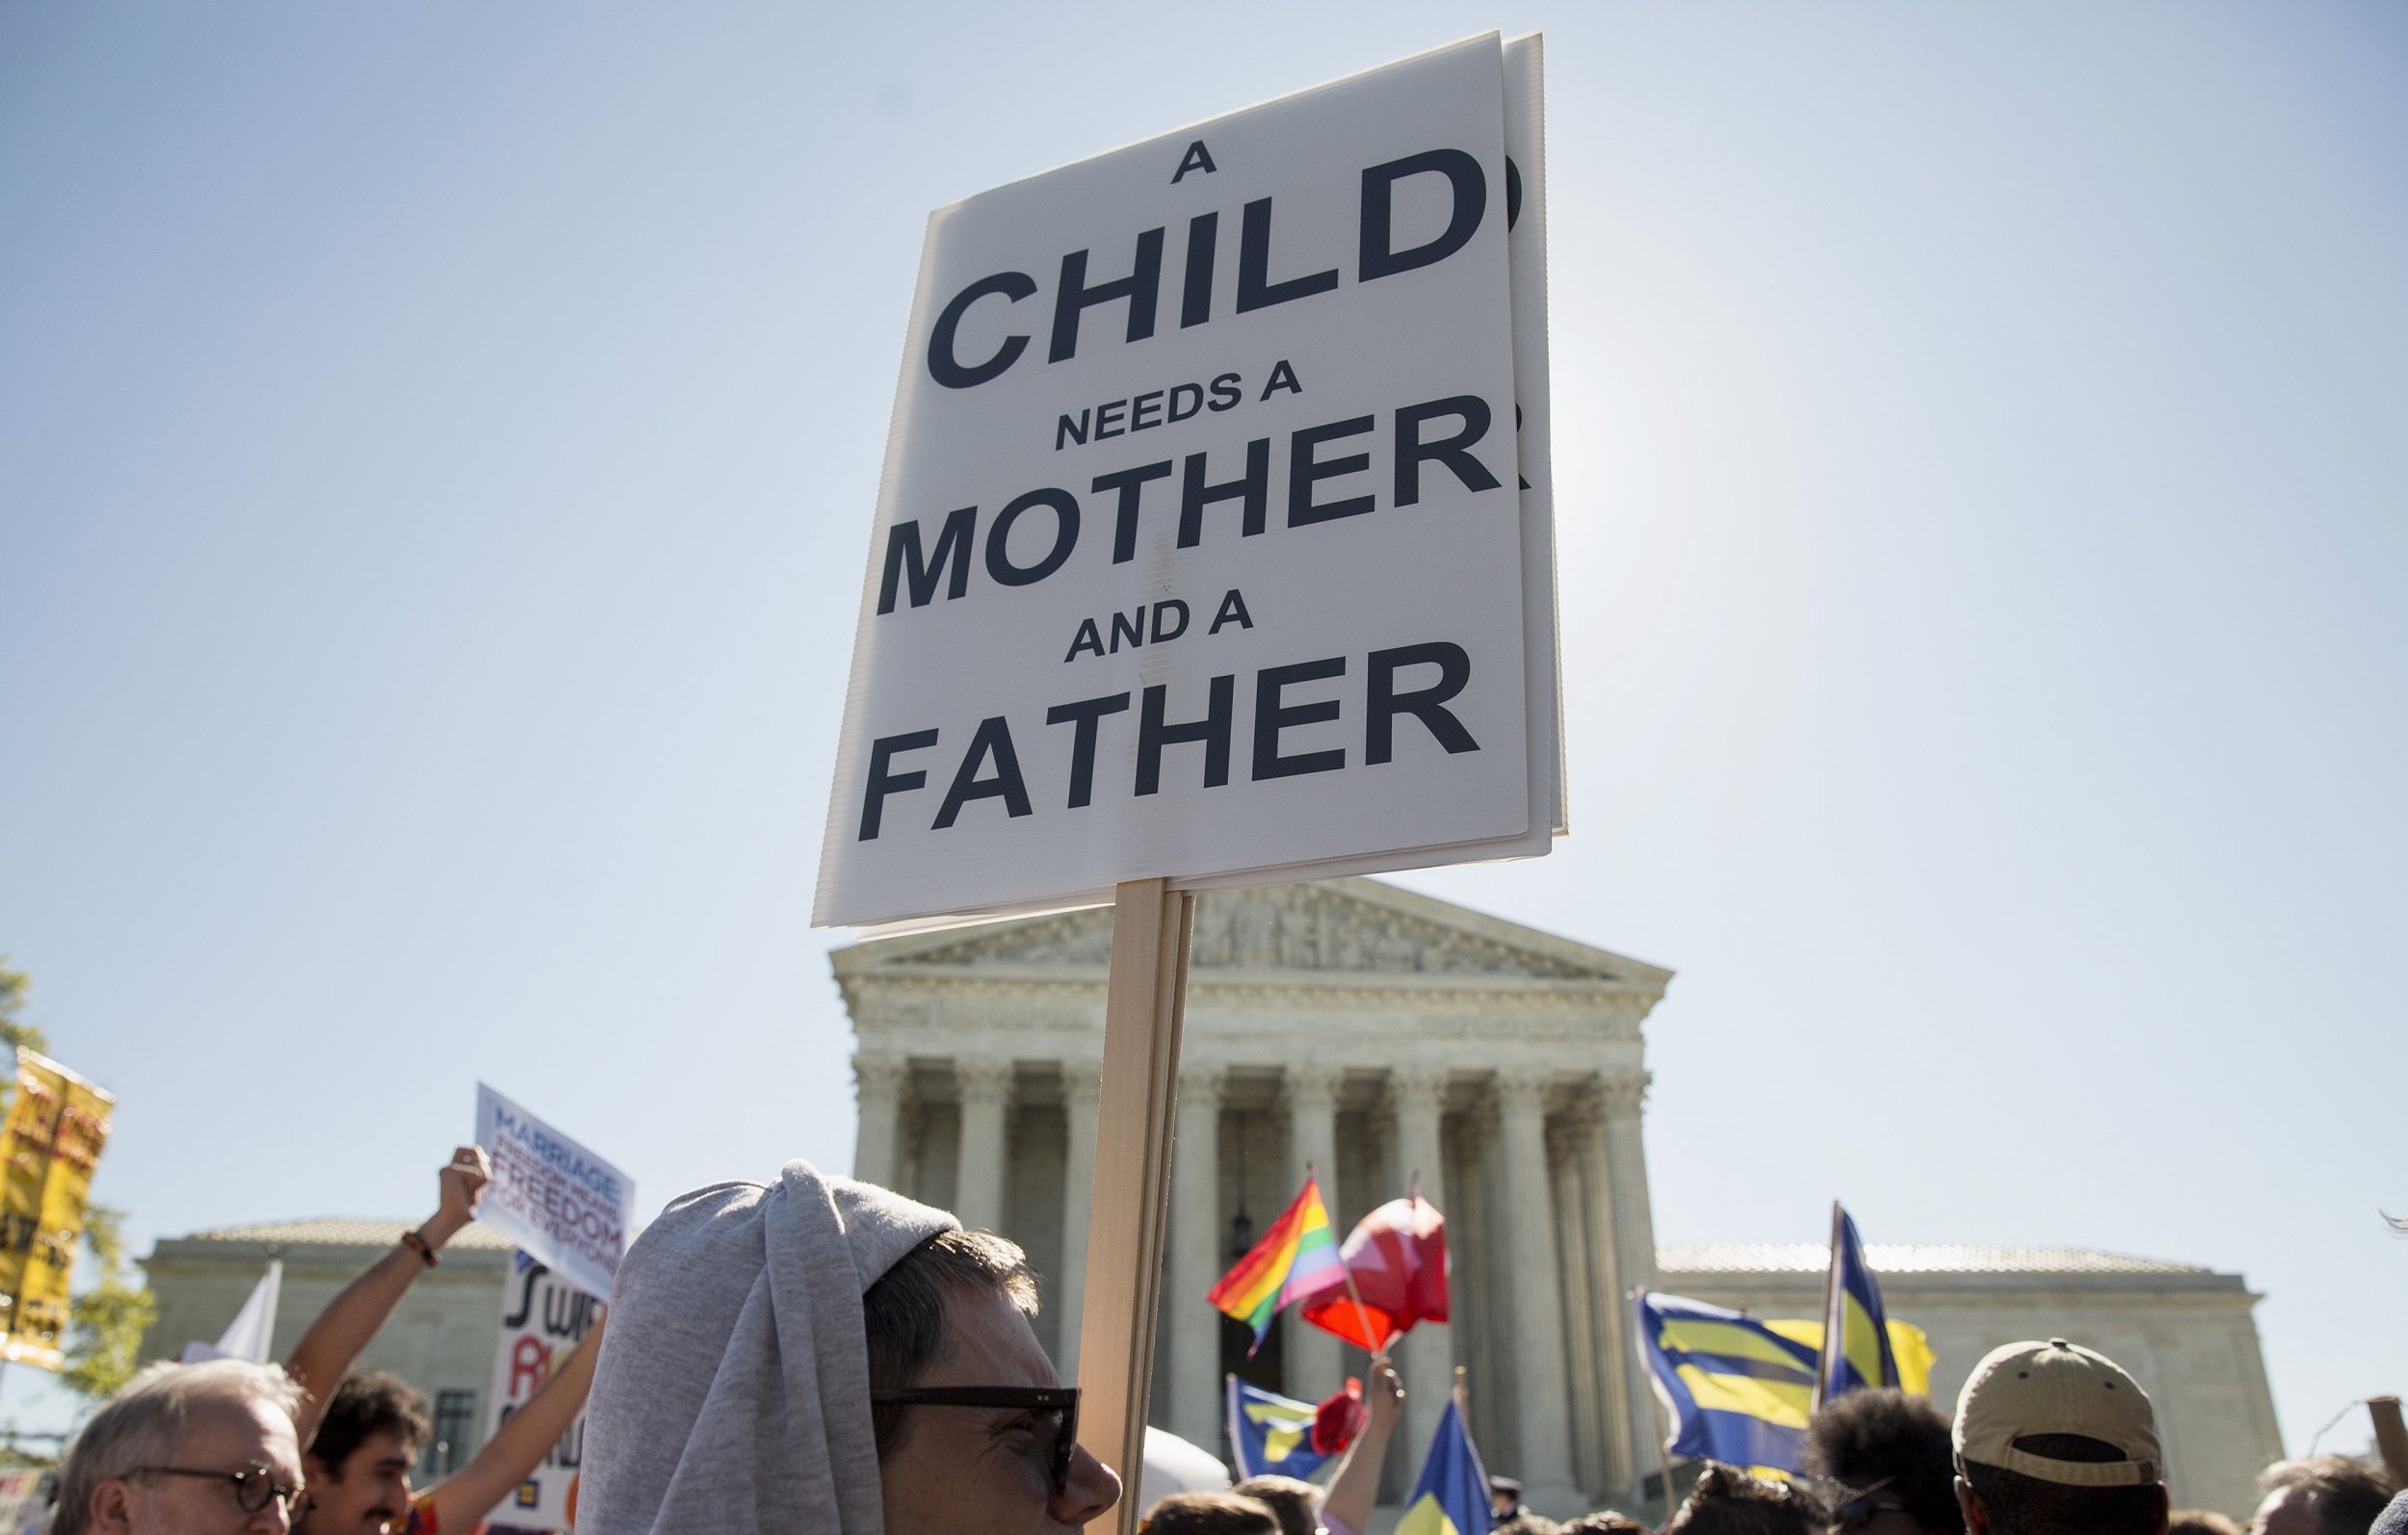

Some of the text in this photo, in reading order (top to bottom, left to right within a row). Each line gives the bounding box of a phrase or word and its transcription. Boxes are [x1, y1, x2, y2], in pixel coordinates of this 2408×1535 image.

[1171, 141, 1217, 184] A
[928, 148, 1487, 390] CHILD
[1055, 359, 1303, 452] NEEDS A
[877, 395, 1503, 616] MOTHER
[1063, 589, 1254, 663] AND A
[857, 641, 1481, 843] FATHER
[492, 1150, 622, 1251] FREEDOM
[494, 1107, 622, 1203] MARRIAGE
